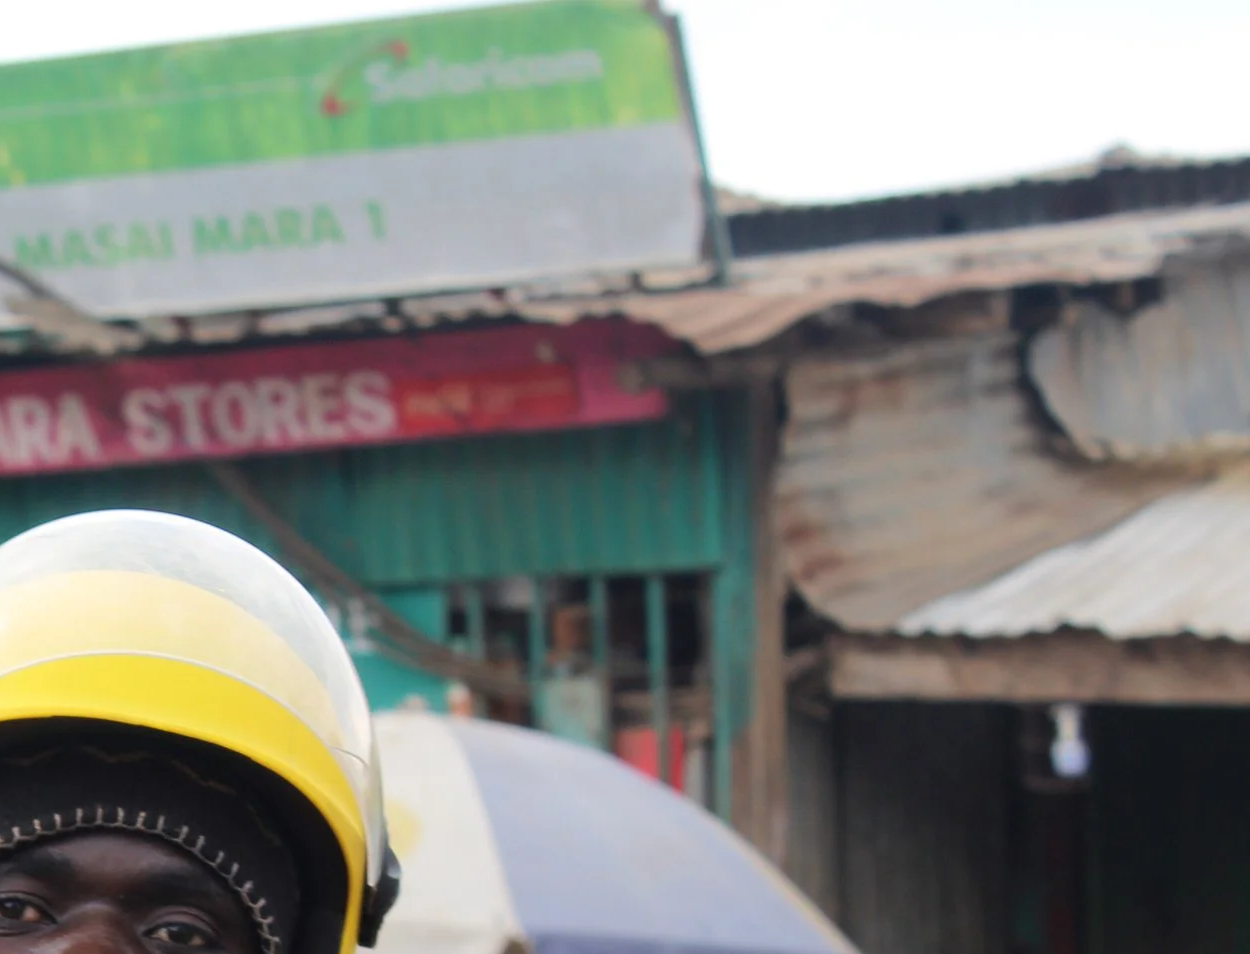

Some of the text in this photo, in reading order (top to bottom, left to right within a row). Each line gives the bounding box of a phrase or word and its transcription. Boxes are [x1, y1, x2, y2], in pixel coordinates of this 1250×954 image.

[13, 197, 388, 268] MASAI MARA 1
[122, 370, 397, 455] STORES
